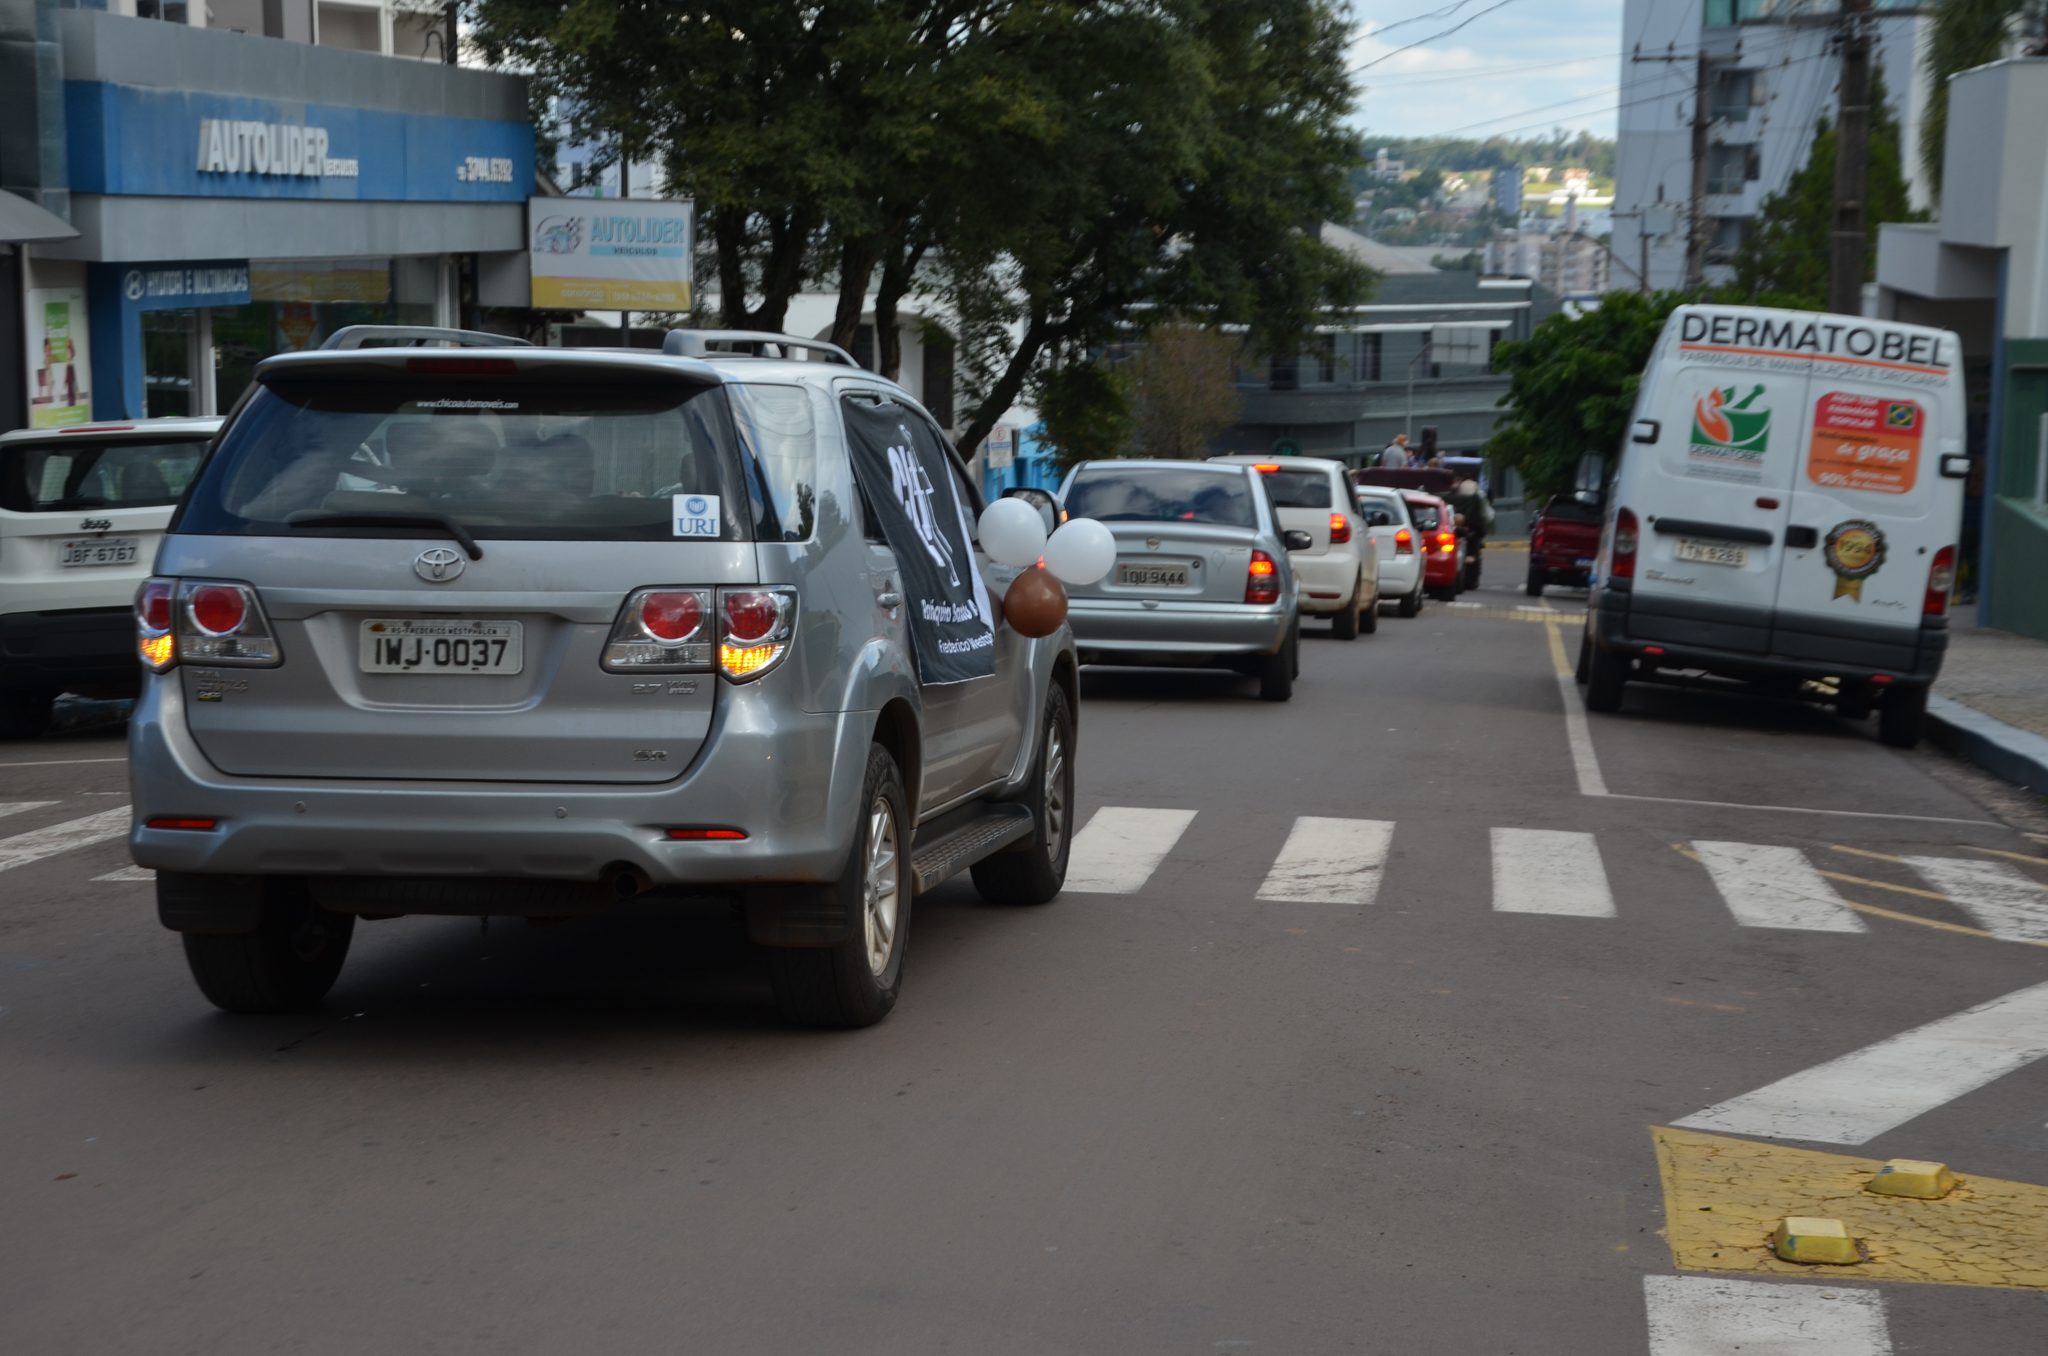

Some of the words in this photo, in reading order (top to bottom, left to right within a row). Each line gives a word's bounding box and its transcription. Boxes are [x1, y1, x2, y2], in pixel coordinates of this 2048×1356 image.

[205, 119, 328, 176] AUTOLIDER
[591, 216, 685, 244] AUTOLIDER
[1681, 313, 1951, 368] DERMATOBEL
[81, 518, 112, 530] Jeep
[677, 517, 717, 535] URI
[938, 639, 970, 653] Frederico
